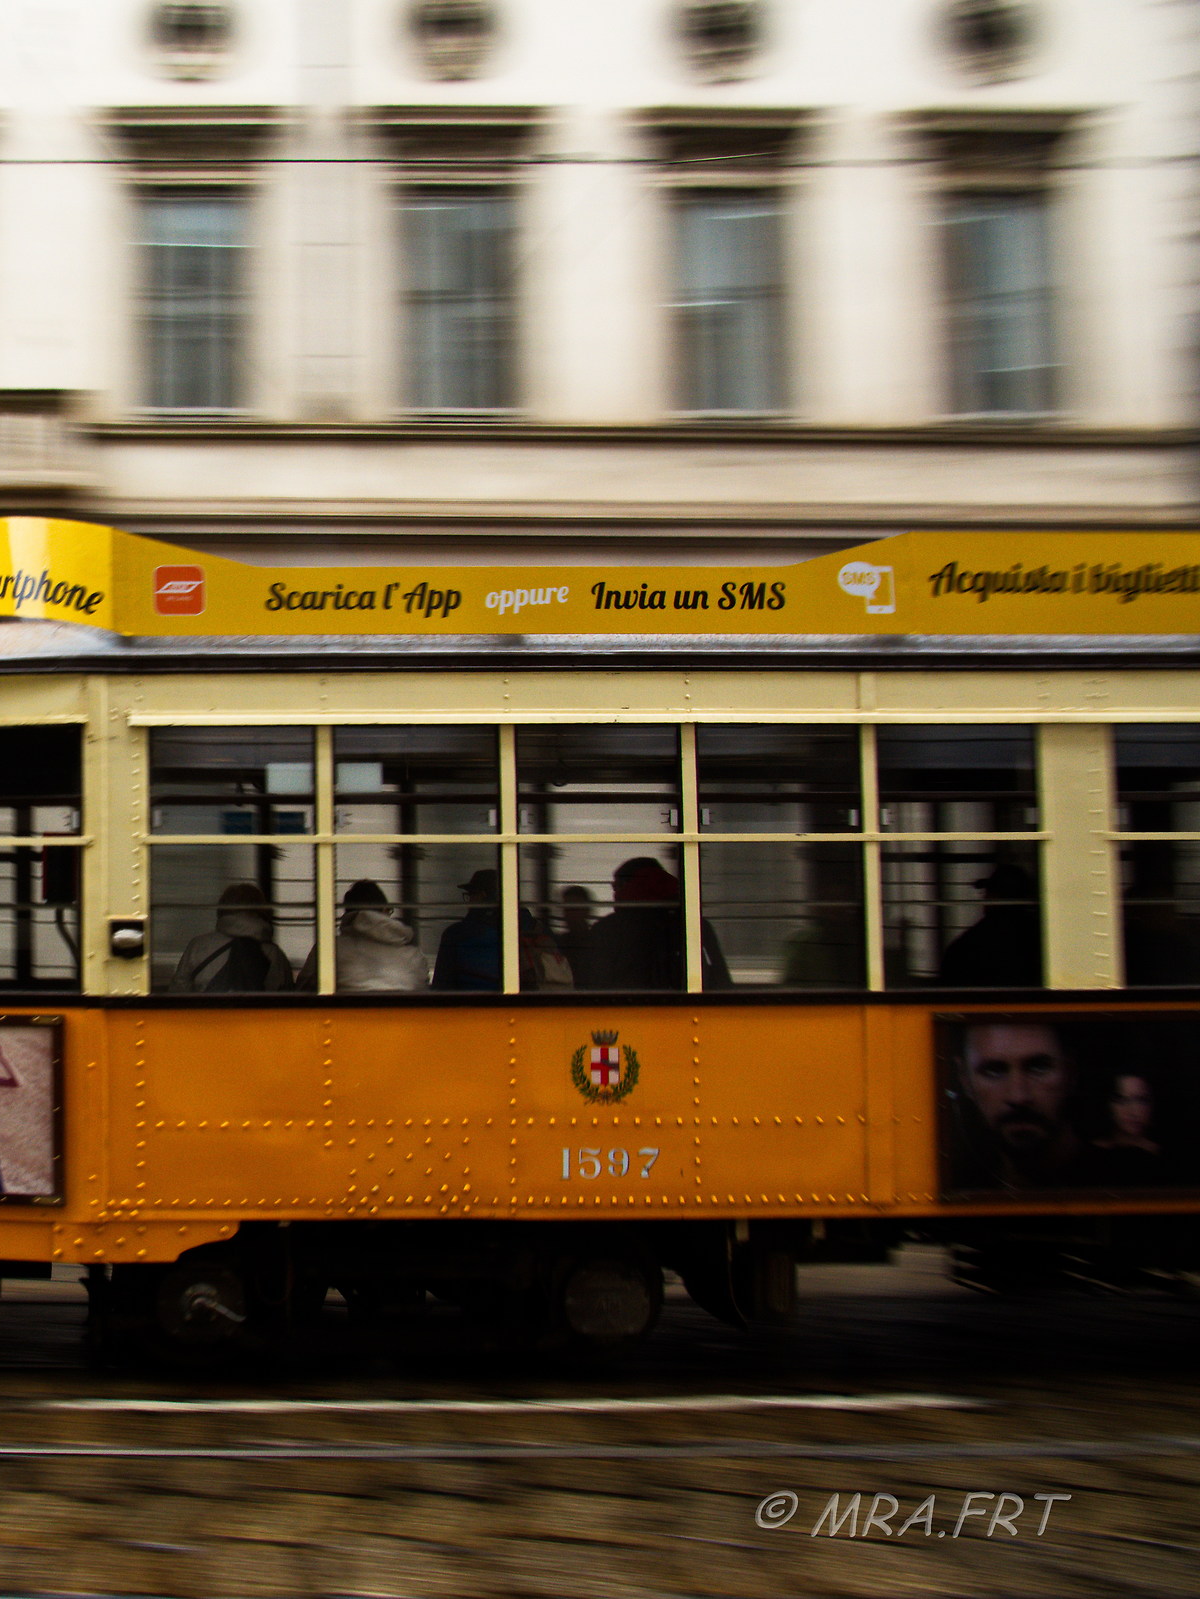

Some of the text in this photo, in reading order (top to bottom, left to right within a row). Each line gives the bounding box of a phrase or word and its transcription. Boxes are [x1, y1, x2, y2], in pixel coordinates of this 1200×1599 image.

[842, 571, 876, 586] SMS
[928, 560, 1071, 604] Acquista
[265, 582, 377, 612] Scarica
[485, 585, 570, 615] oppure
[591, 581, 667, 611] Invia
[673, 589, 710, 611] un
[717, 581, 787, 611] SMS
[560, 1146, 661, 1181] 1597
